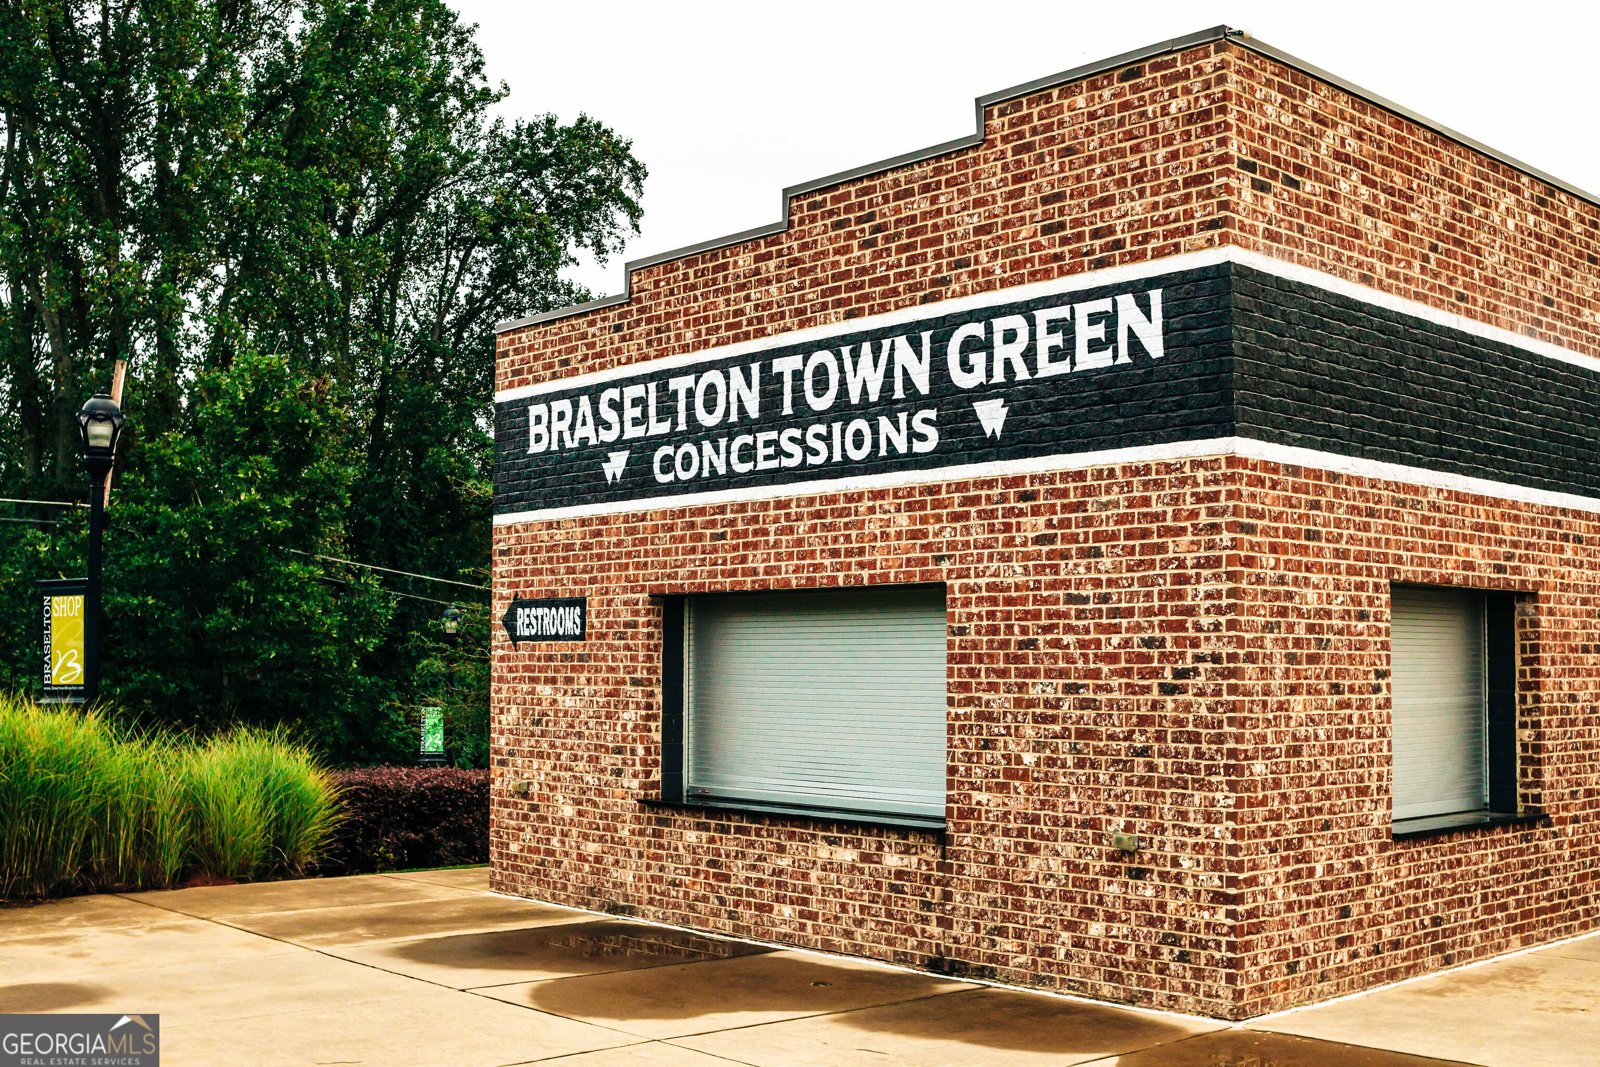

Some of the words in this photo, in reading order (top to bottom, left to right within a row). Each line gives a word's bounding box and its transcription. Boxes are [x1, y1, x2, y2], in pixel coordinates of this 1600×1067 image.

[527, 361, 762, 454] BRASELTON
[772, 329, 933, 416] TOWN
[947, 288, 1165, 389] GREEN
[652, 407, 940, 484] CONCESSIONS
[43, 596, 52, 685] BRASELTON
[53, 596, 82, 617] SHOP
[516, 606, 581, 636] RESTROOMS
